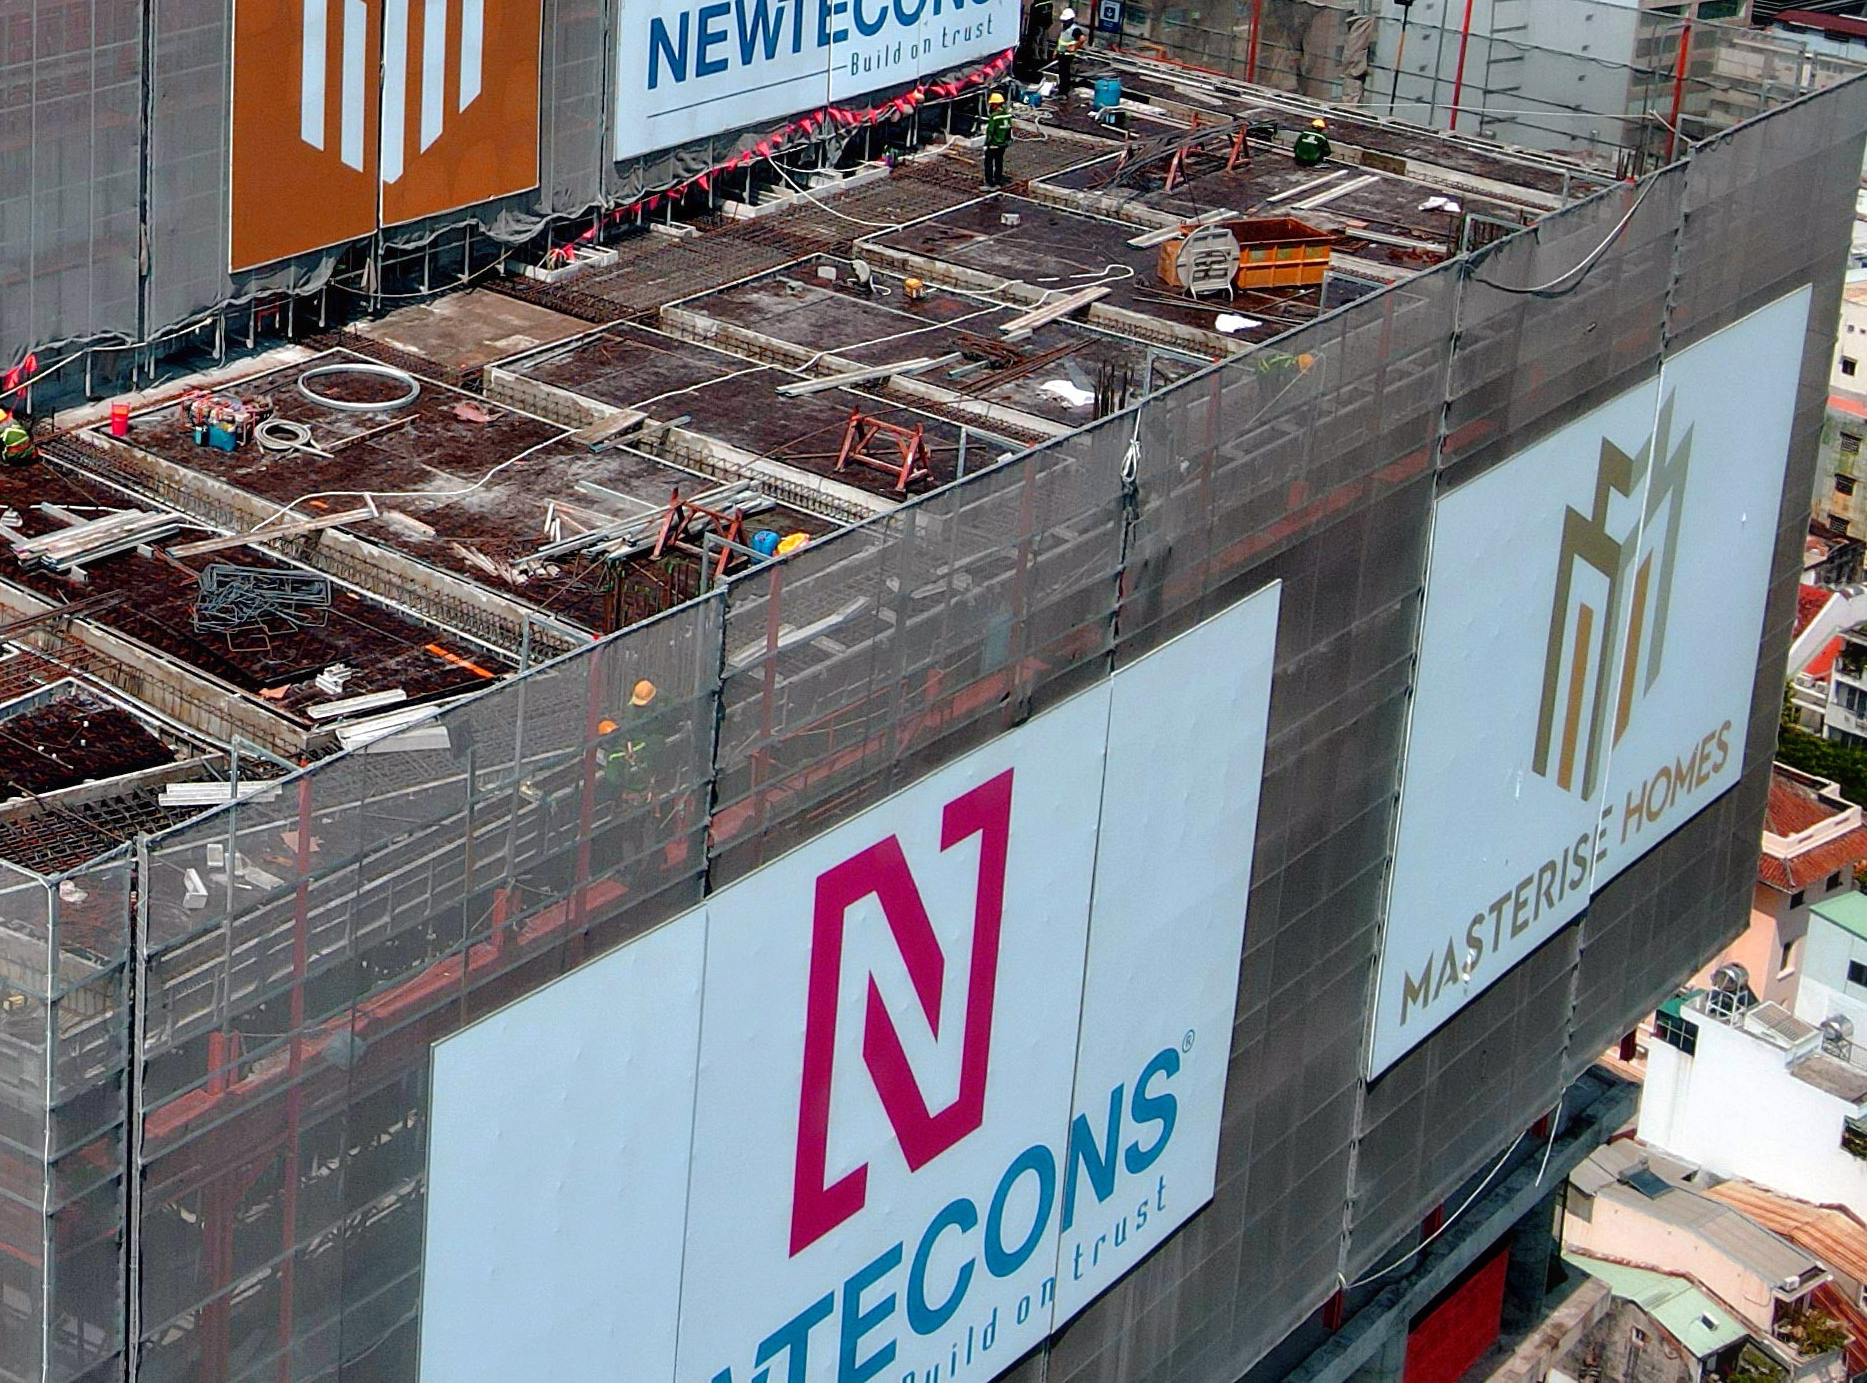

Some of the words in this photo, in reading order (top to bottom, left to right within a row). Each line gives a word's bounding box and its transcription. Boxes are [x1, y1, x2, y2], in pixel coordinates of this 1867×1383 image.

[851, 41, 901, 76] Build
[911, 38, 931, 59] on
[942, 13, 993, 48] trust
[1400, 805, 1613, 1027] MASTERISE
[1621, 720, 1731, 844] HOMES
[1017, 1276, 1055, 1324] on
[1074, 1176, 1166, 1281] trust
